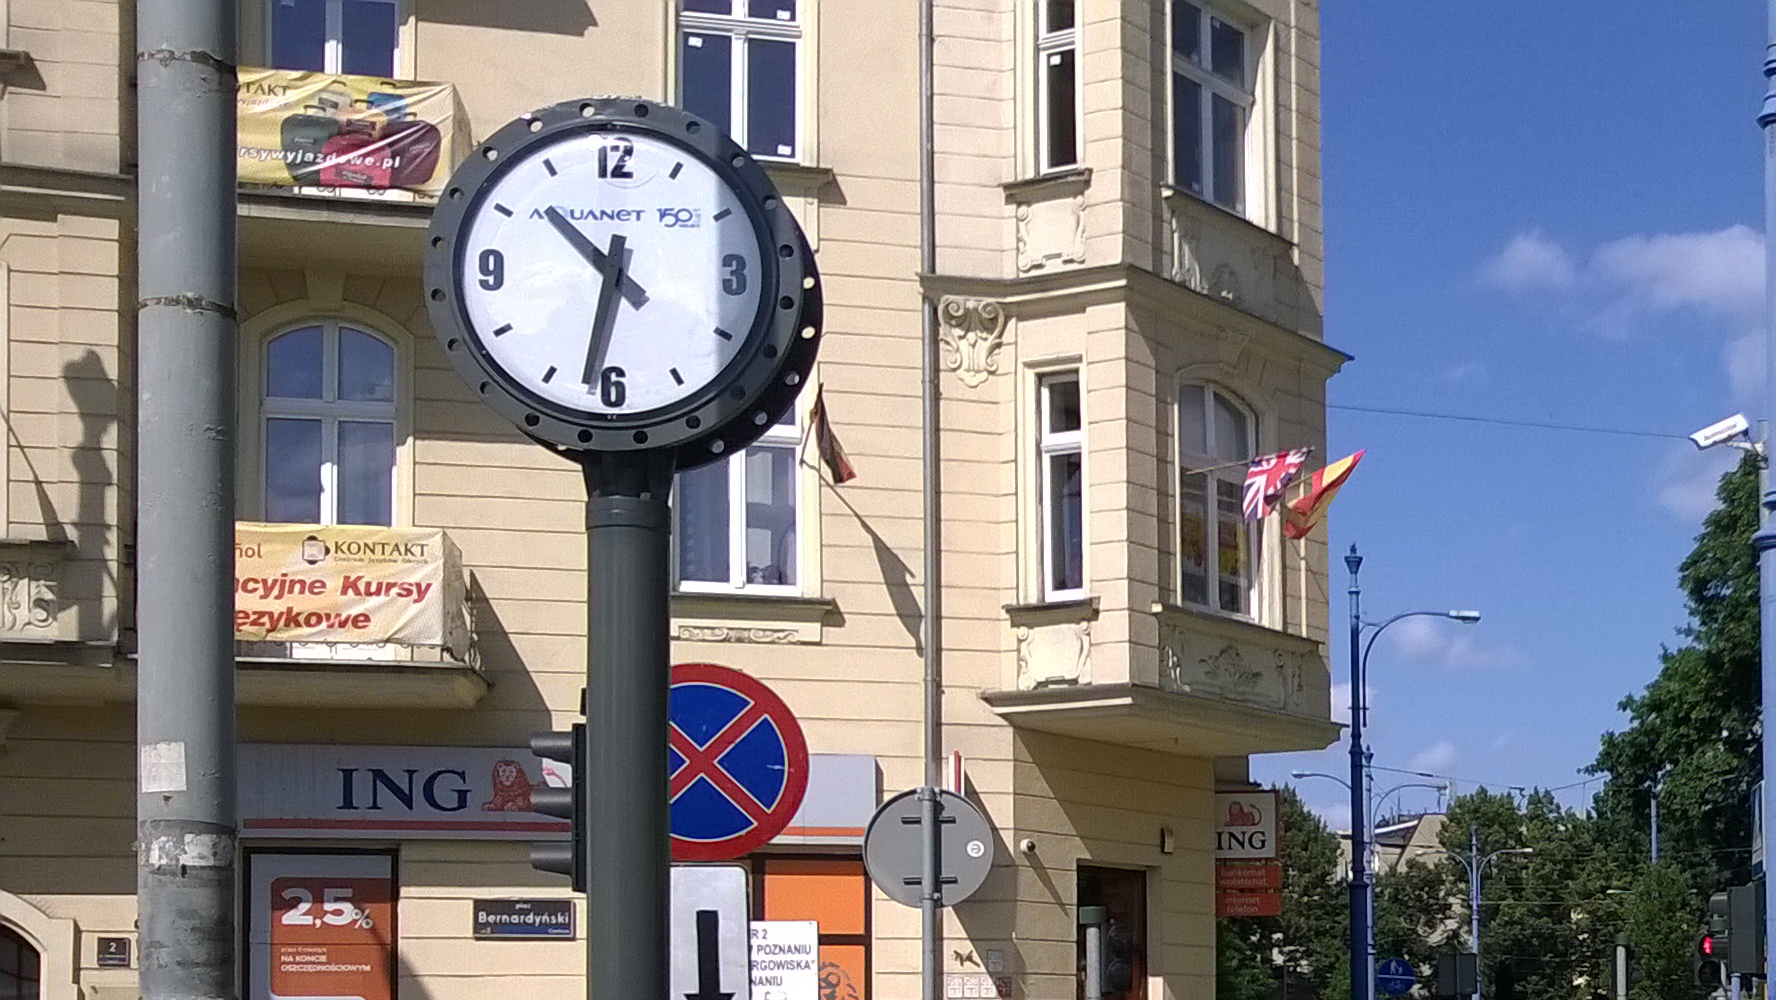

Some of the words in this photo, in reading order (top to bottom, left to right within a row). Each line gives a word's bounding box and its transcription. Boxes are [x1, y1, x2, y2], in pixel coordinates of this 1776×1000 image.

[237, 82, 290, 97] TAKT
[238, 147, 401, 169] rsywyjazdwe.pl
[598, 137, 634, 179] 12
[478, 249, 505, 291] 9
[721, 254, 747, 295] 3
[600, 366, 626, 408] 6
[235, 542, 262, 559] ñol
[333, 541, 429, 557] KONTAKT
[235, 573, 327, 600] cyjne
[340, 575, 433, 603] Kursy
[234, 606, 371, 633] ęzykowe
[335, 768, 472, 812] ING
[1216, 830, 1267, 850] ING
[281, 888, 373, 929] 2,5%
[478, 911, 569, 927] Bernardyński
[761, 928, 768, 940] 2
[109, 941, 117, 953] 2
[756, 944, 811, 956] POZNANIU
[751, 959, 815, 971] RGOWISKA"
[751, 975, 783, 987] NANIU
